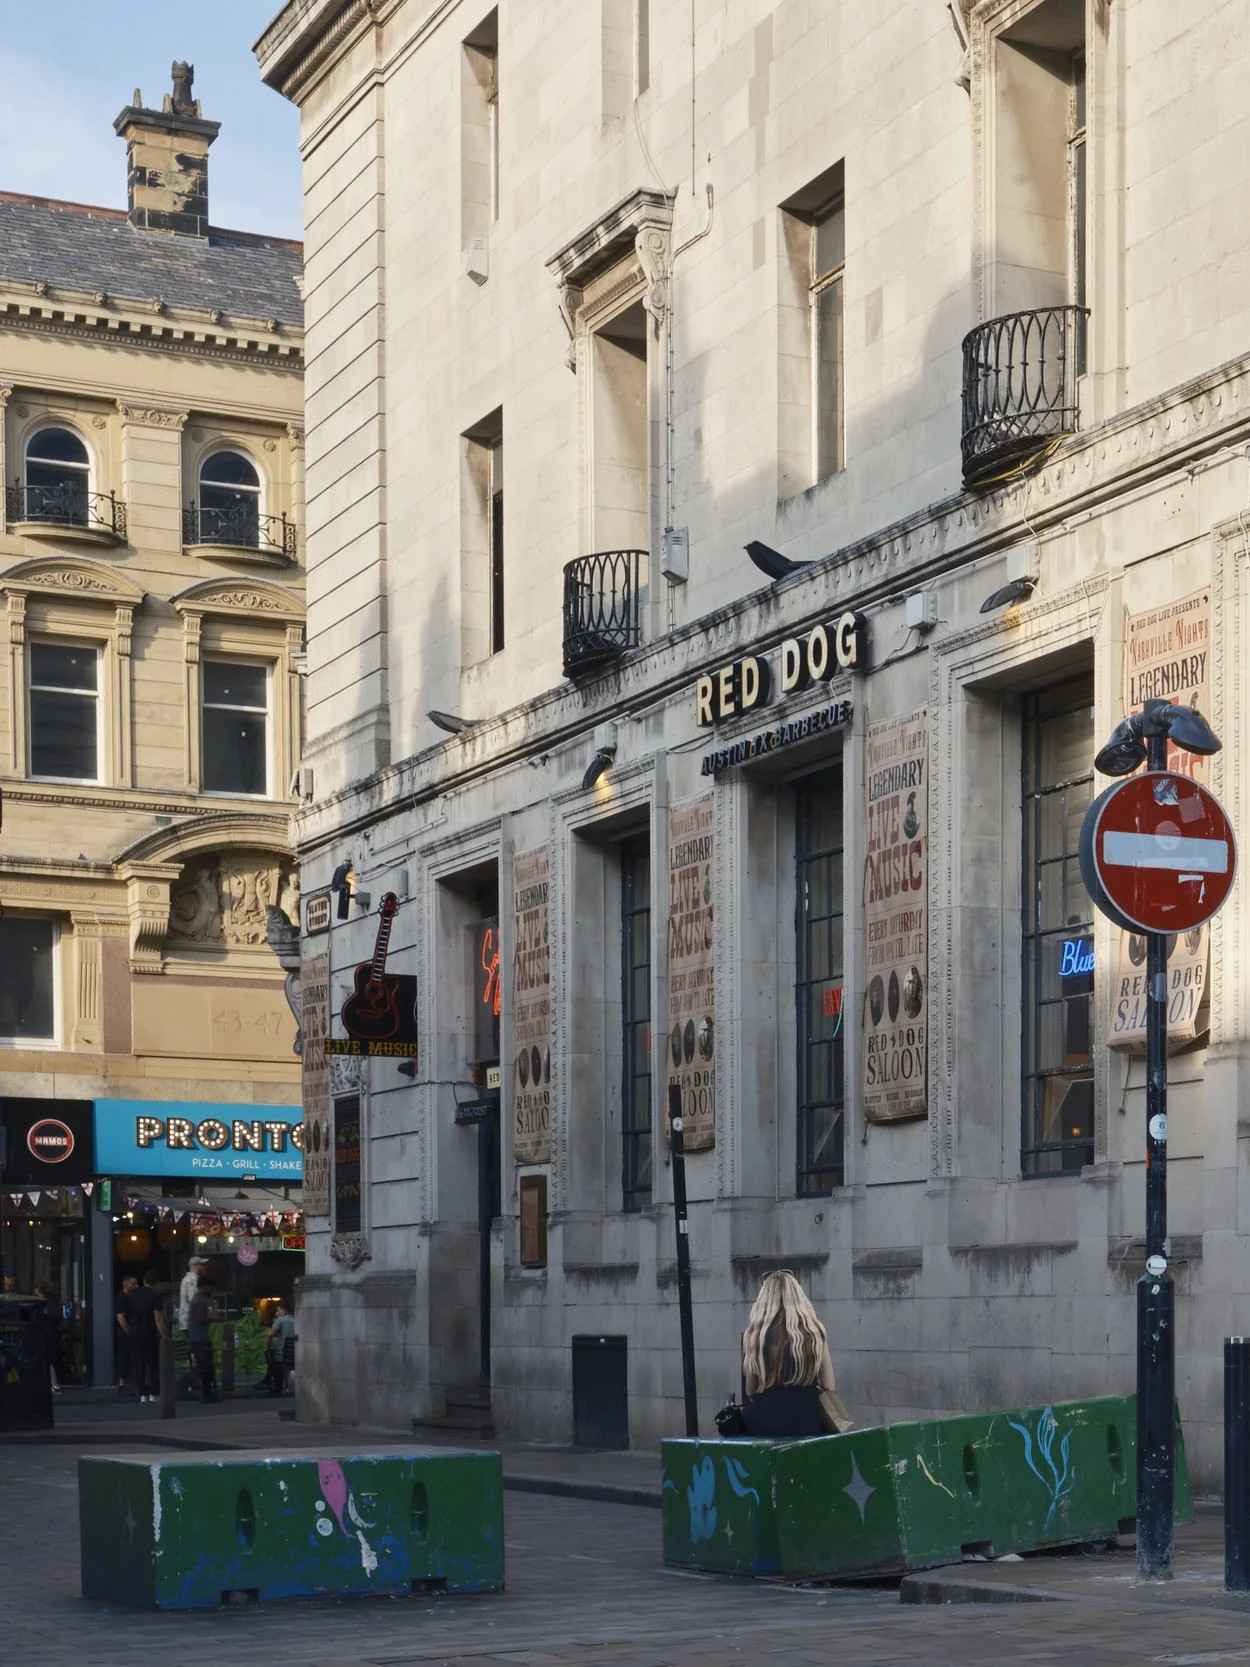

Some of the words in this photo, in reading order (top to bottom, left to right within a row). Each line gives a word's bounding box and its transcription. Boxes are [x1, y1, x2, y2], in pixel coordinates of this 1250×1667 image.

[1136, 618, 1146, 630] RED
[1147, 613, 1157, 627] DOG
[1158, 608, 1171, 623] LIVE
[1171, 599, 1201, 617] PRESENTS
[1129, 630, 1173, 667] NASHVILLE
[1175, 617, 1209, 650] NIGHTS
[696, 655, 769, 728] RED
[781, 611, 867, 693] DOG
[1130, 651, 1207, 707] LEGENDARY
[701, 740, 749, 776] AUSTIN
[751, 731, 771, 757] TX
[773, 700, 853, 748] BARBECUE
[869, 758, 925, 801] LEGENDARY
[868, 794, 900, 853] LIVE
[671, 865, 700, 915] LIVE
[869, 840, 922, 903] MUSIC
[515, 881, 549, 912] LEGENDAR
[515, 909, 541, 952] LIVE
[671, 905, 714, 959] MUSIC
[1058, 939, 1095, 976] Blue
[1172, 964, 1203, 989] DOG
[212, 1009, 284, 1037] 43-47
[1114, 986, 1201, 1033] SALON
[326, 1039, 361, 1055] LIVE
[368, 1041, 417, 1057] MUSIC
[868, 1033, 887, 1053] RED
[898, 1027, 924, 1047] DOG
[867, 1047, 924, 1085] SALOON
[34, 1136, 68, 1146] MAMOS
[516, 1108, 549, 1135] SALOO
[192, 1158, 223, 1168] PIZZA
[232, 1159, 260, 1169] GRILL
